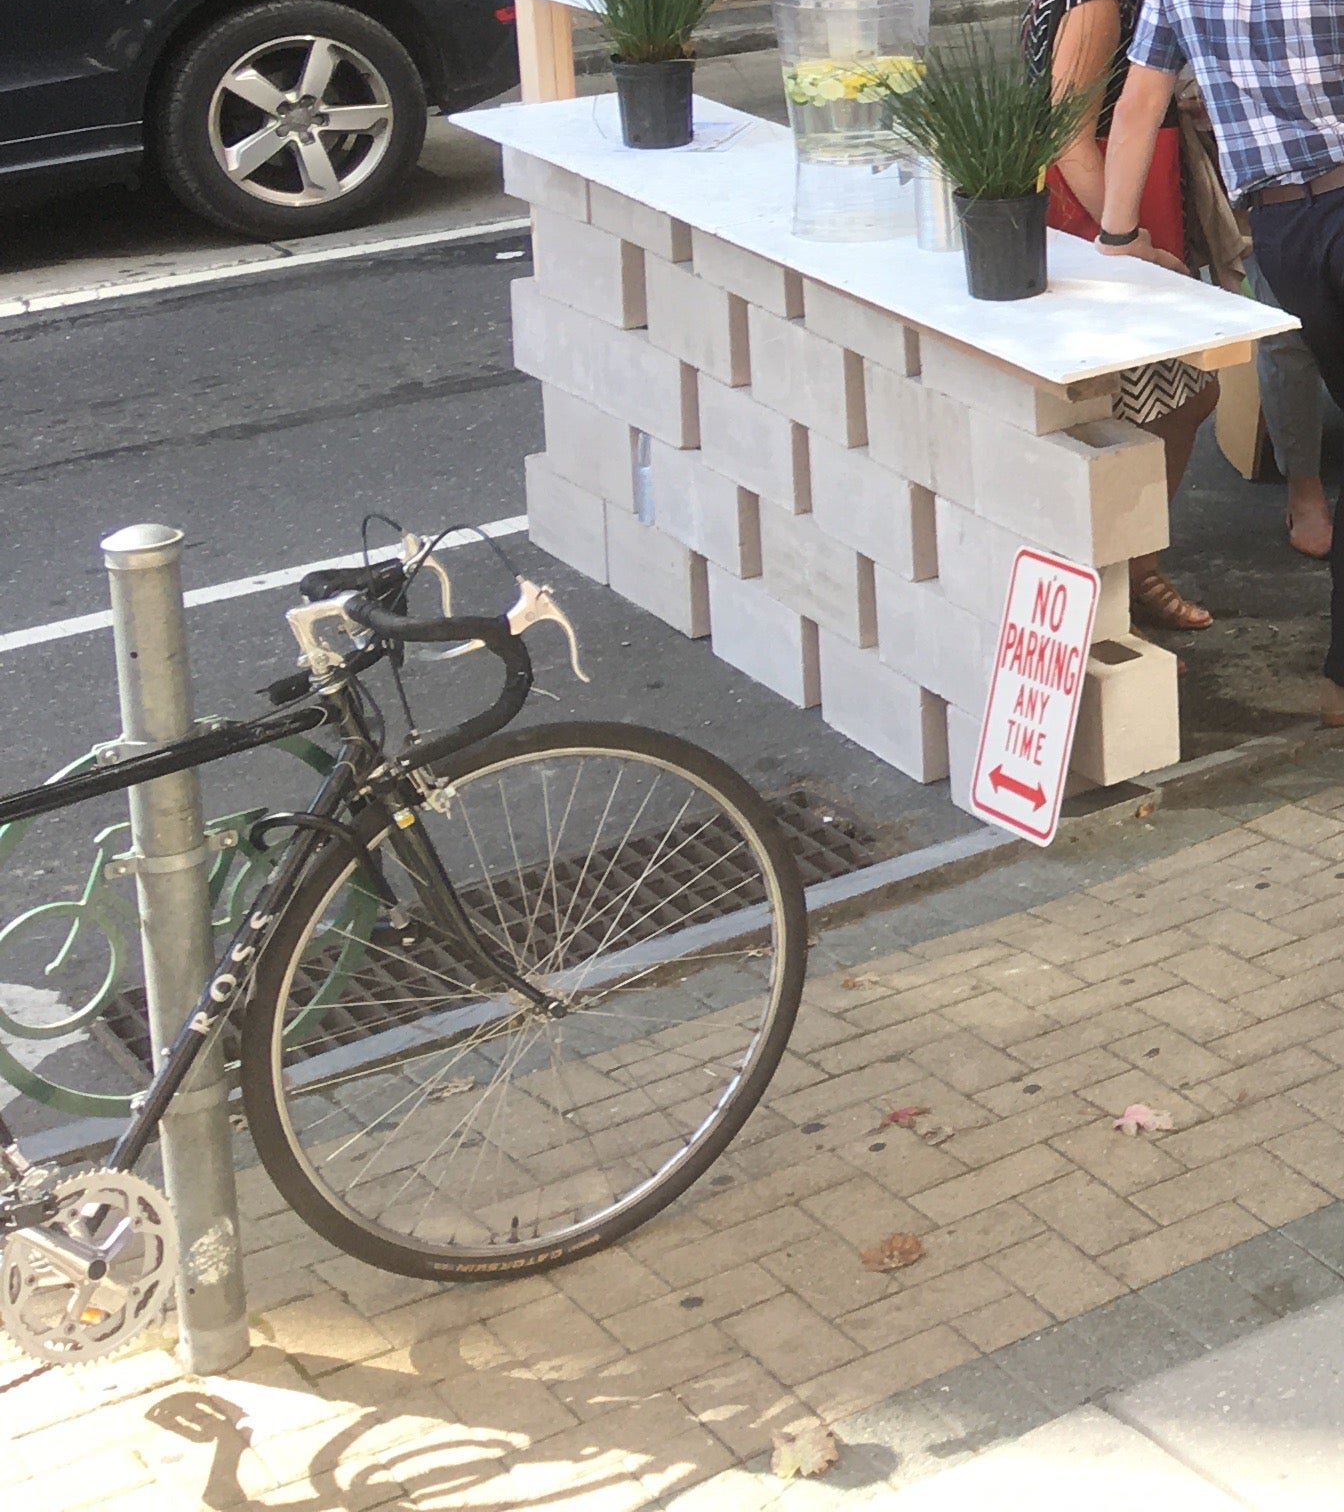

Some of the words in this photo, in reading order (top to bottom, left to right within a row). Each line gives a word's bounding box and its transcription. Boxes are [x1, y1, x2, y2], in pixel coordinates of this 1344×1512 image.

[1031, 578, 1068, 634] NO
[1000, 621, 1080, 697] PARKING
[1014, 683, 1051, 725] ANY
[1004, 718, 1048, 767] TIME
[187, 909, 275, 1035] ROSS
